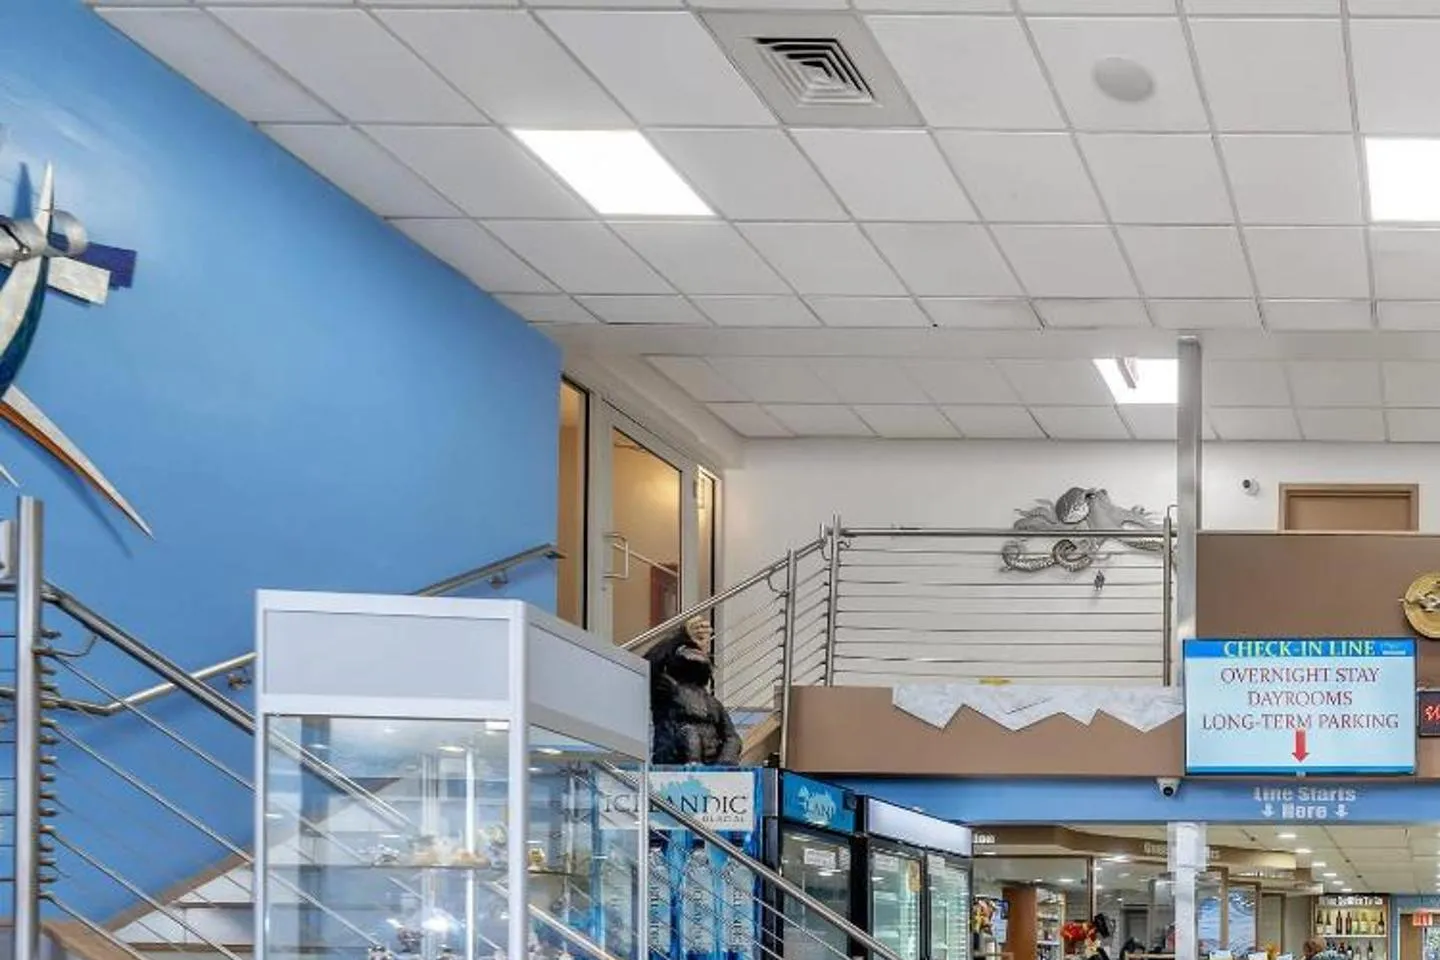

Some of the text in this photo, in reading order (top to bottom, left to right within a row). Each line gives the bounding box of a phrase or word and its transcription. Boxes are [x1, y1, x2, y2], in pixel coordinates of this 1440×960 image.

[1223, 641, 1323, 656] CHECK-IN
[1329, 641, 1376, 656] LINE
[1220, 667, 1380, 683] OVERNIGHT STAY
[1248, 690, 1353, 706] DAYROOMS
[1202, 713, 1399, 729] LONG-TERM PARKING
[1253, 786, 1356, 801] Line Starts
[603, 794, 748, 815] ICLANDIC
[1282, 803, 1327, 819] Here
